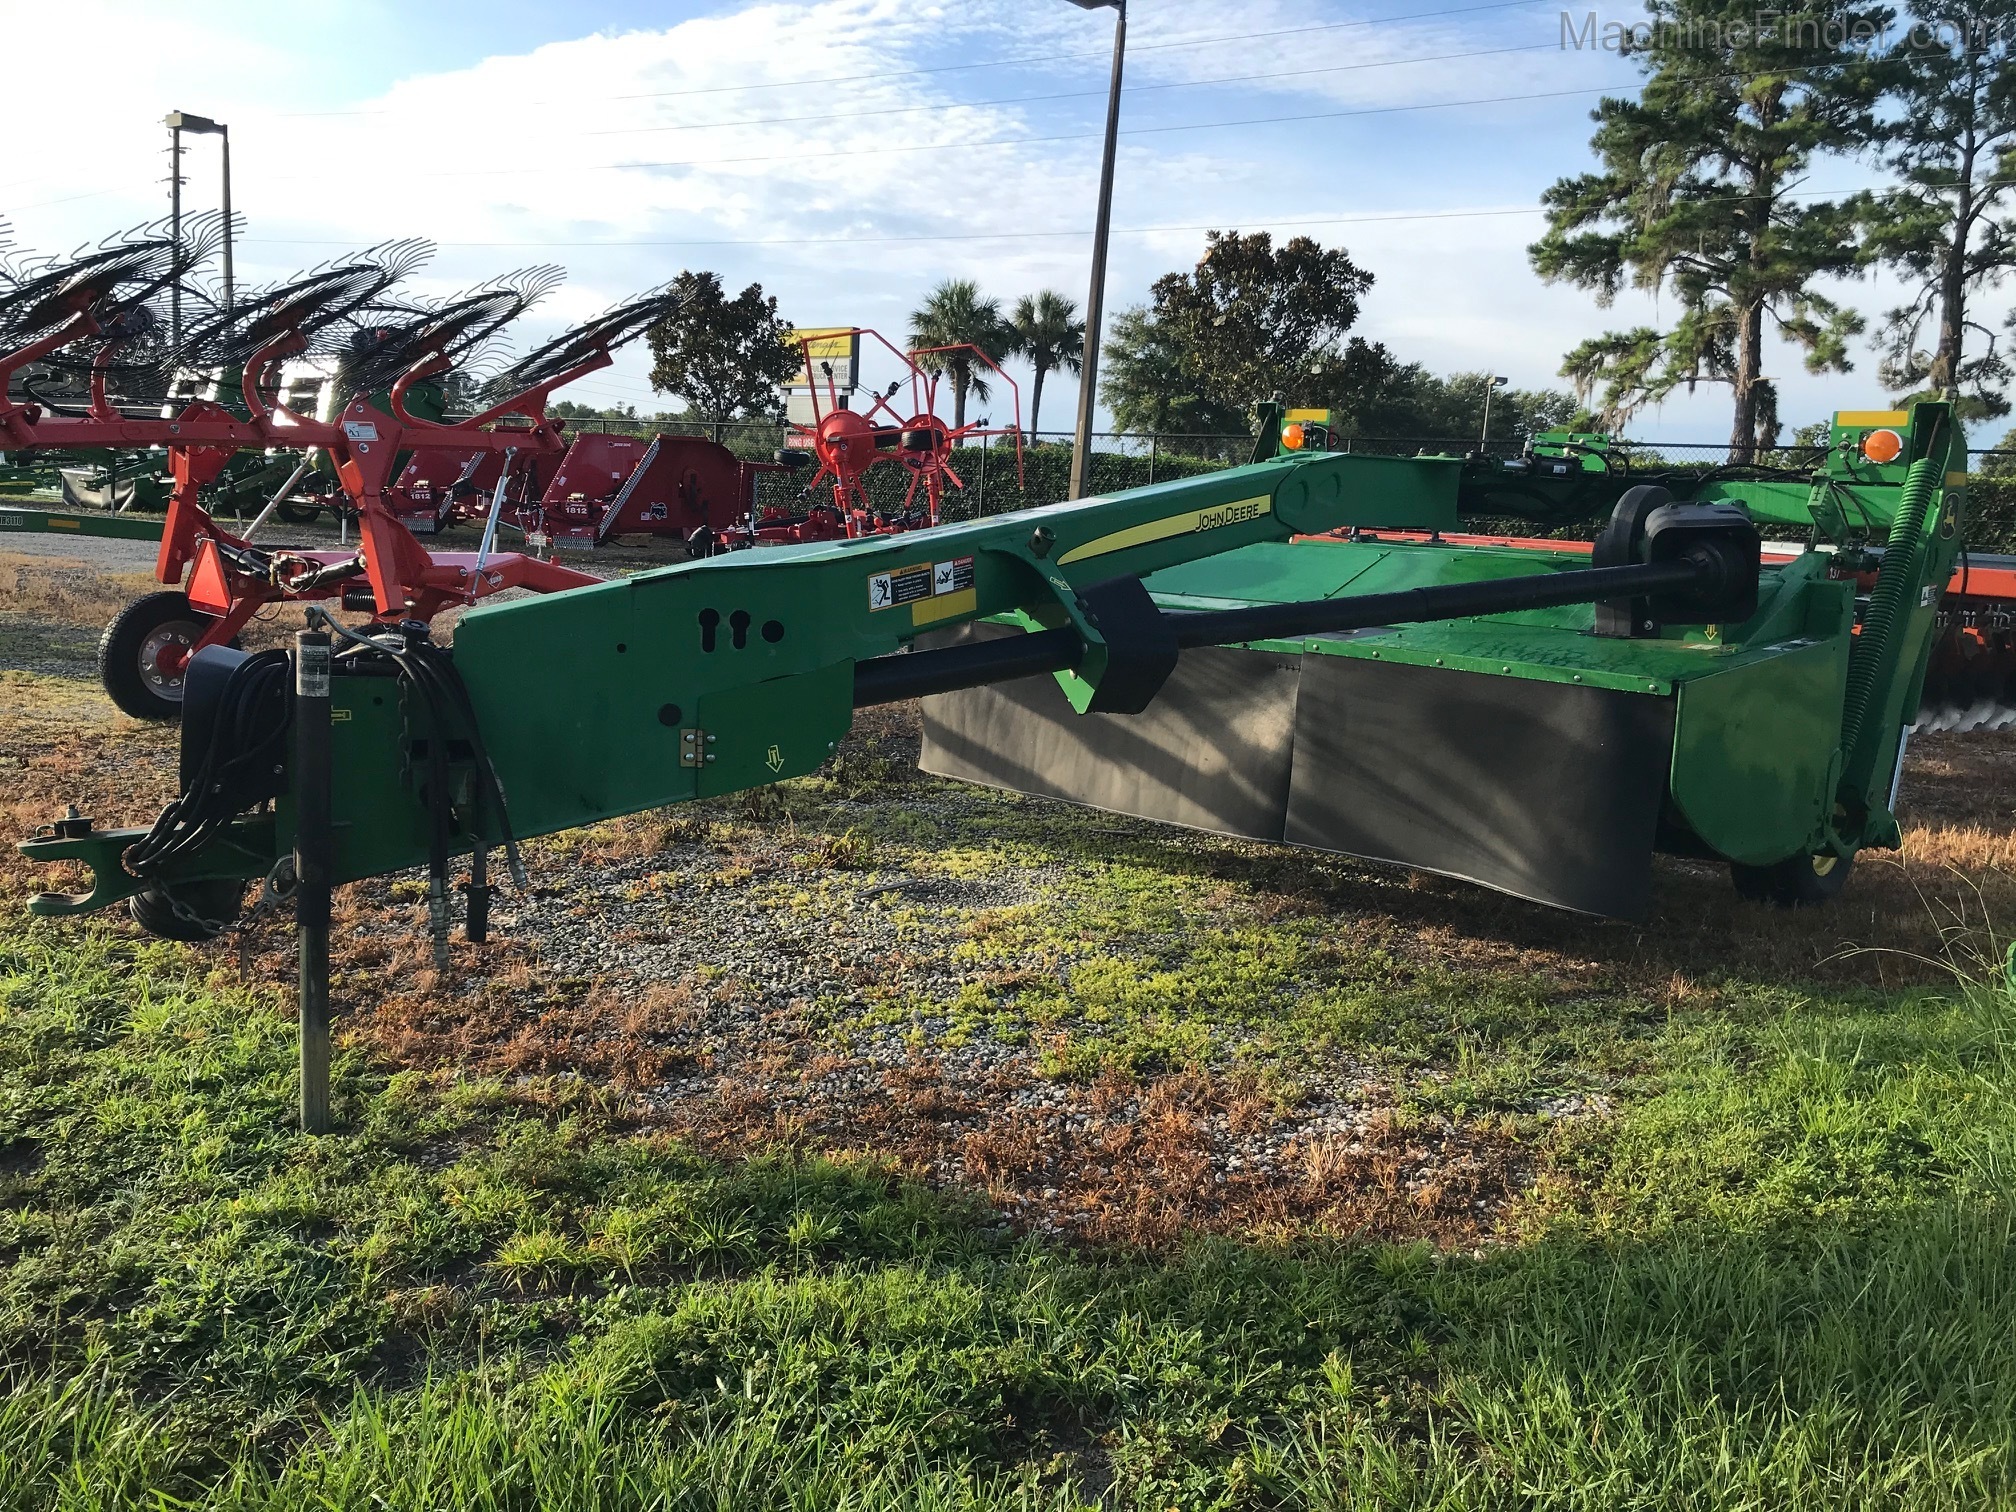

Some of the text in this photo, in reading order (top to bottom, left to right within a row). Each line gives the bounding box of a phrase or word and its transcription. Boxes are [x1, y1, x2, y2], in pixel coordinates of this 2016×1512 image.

[0, 515, 24, 527] R3110
[1195, 503, 1260, 531] JOHN DEERE
